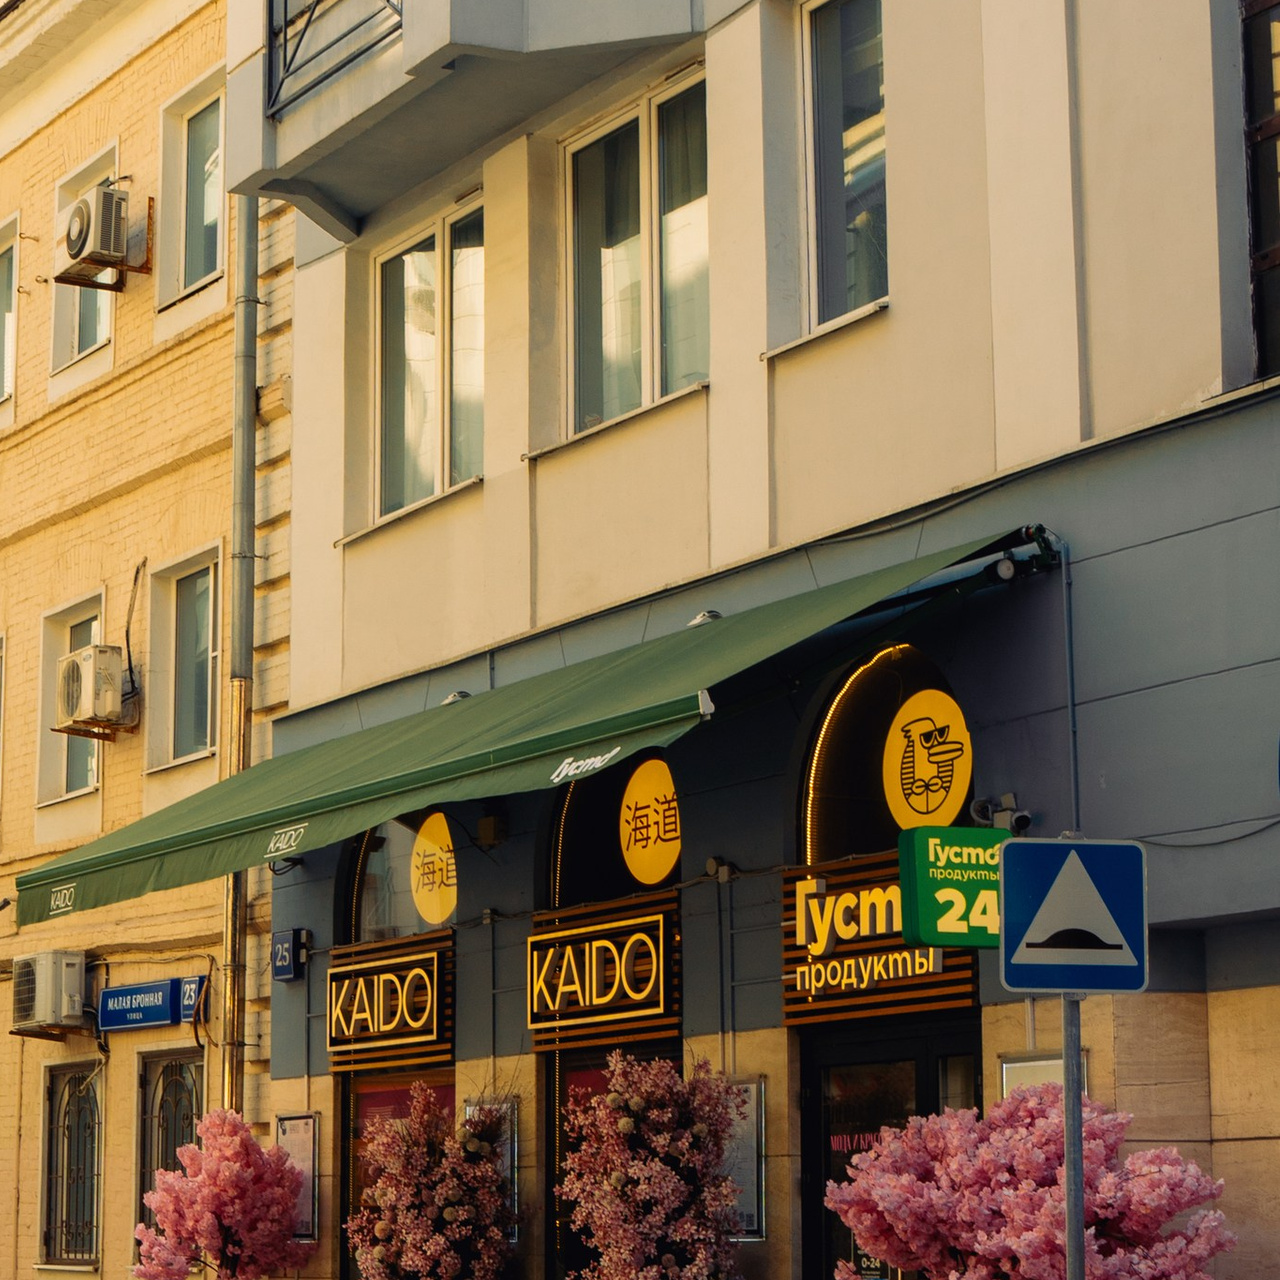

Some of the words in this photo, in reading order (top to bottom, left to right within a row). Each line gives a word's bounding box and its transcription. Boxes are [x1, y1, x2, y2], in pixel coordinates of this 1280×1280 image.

[266, 828, 304, 853] KAIDO
[928, 868, 1000, 882] продукты
[50, 887, 75, 910] KAIDO
[934, 887, 1001, 934] 24
[795, 878, 903, 956] Густ
[275, 942, 290, 967] 25
[532, 932, 658, 1013] KAIDO
[796, 947, 935, 995] продукты
[107, 995, 131, 1011] МАЛАЯ
[131, 991, 163, 1009] БРОННАЯ
[183, 983, 196, 1005] 23
[331, 967, 432, 1038] KAIDO
